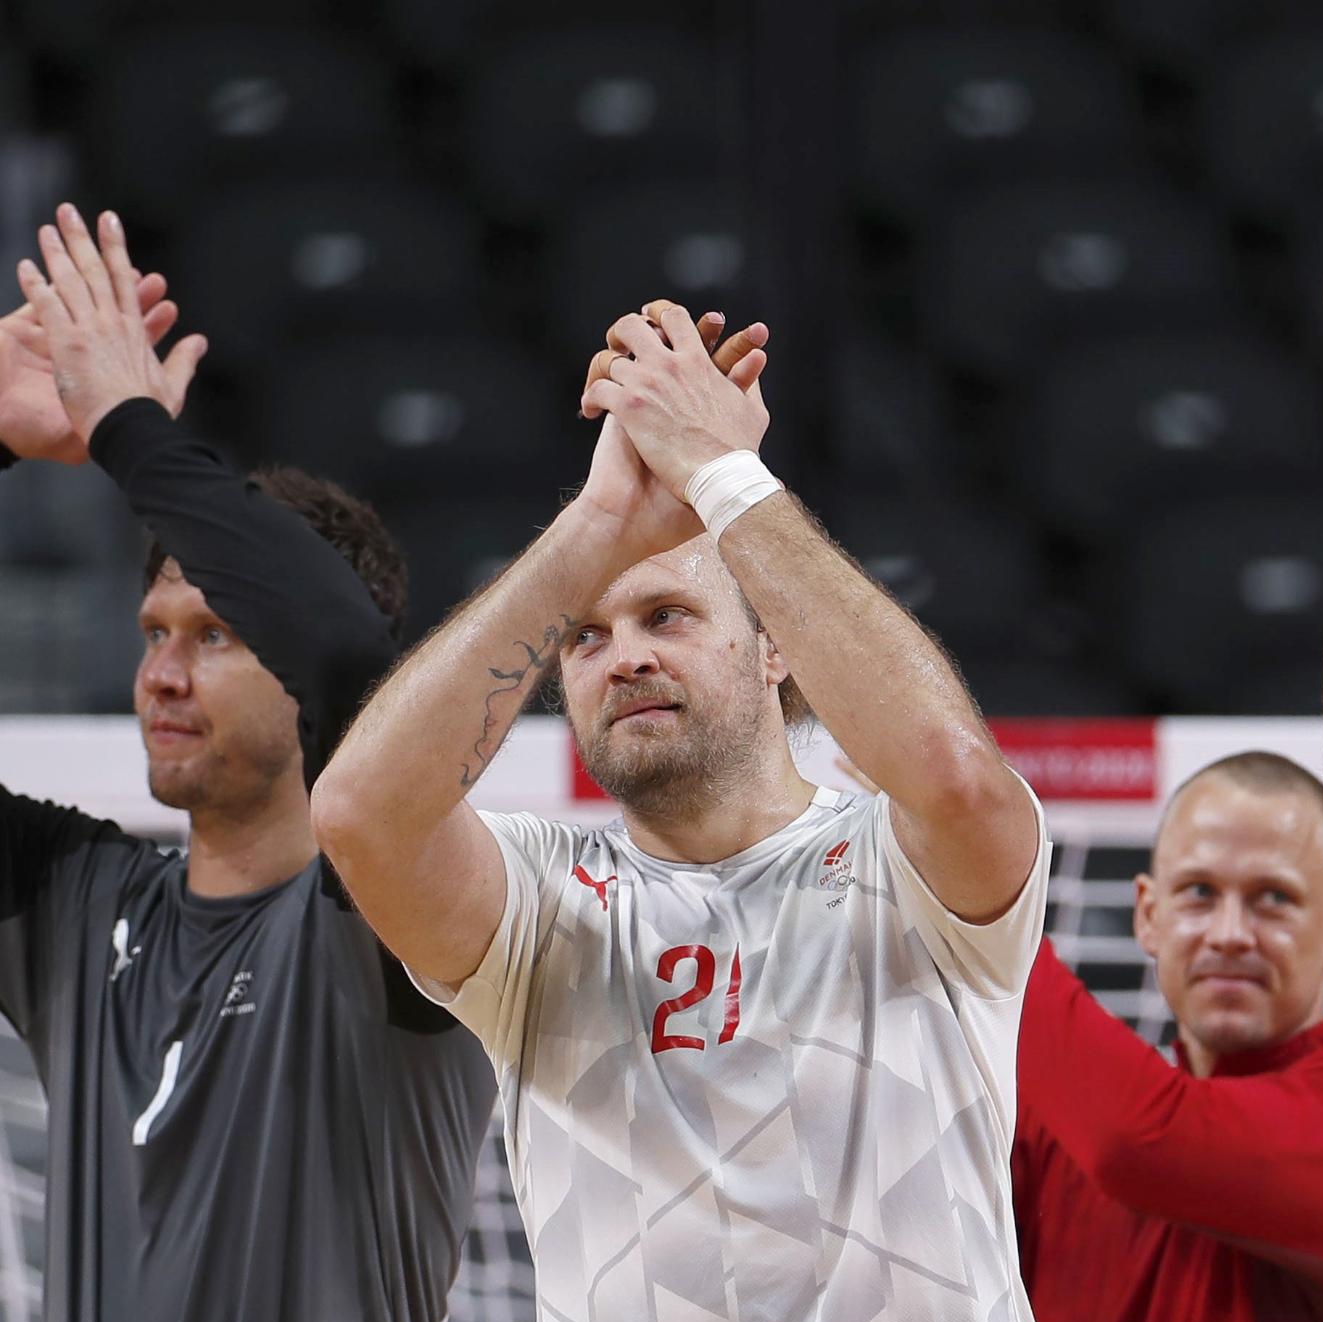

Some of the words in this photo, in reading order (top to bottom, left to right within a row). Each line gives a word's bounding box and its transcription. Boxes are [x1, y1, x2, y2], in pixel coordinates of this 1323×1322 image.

[819, 860, 852, 886] DENMA
[651, 943, 743, 1054] 21
[131, 1040, 184, 1146] 1
